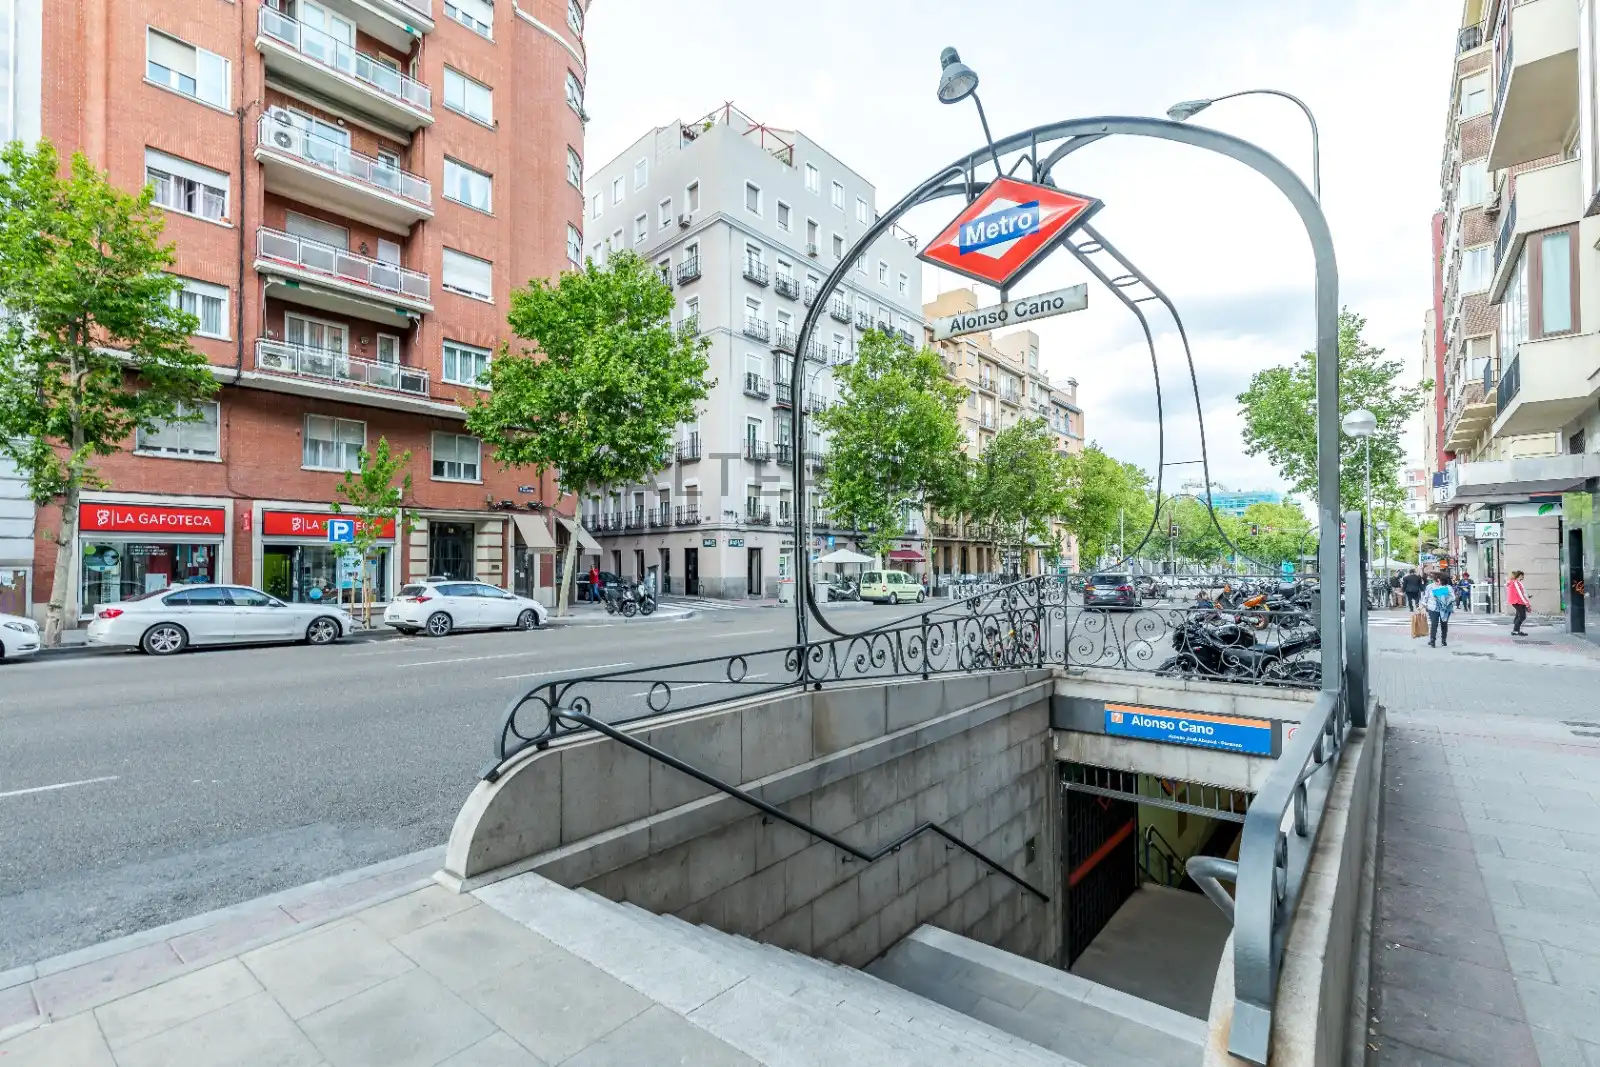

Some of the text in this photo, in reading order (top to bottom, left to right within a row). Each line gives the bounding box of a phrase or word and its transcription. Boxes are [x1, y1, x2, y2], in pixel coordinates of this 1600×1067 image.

[966, 212, 1032, 246] Metro
[950, 295, 1065, 333] Alonso Cano
[116, 513, 212, 527] LA GAFOTECA
[306, 519, 319, 530] LA
[334, 521, 350, 540] P
[1131, 714, 1214, 735] Alonso Cano
